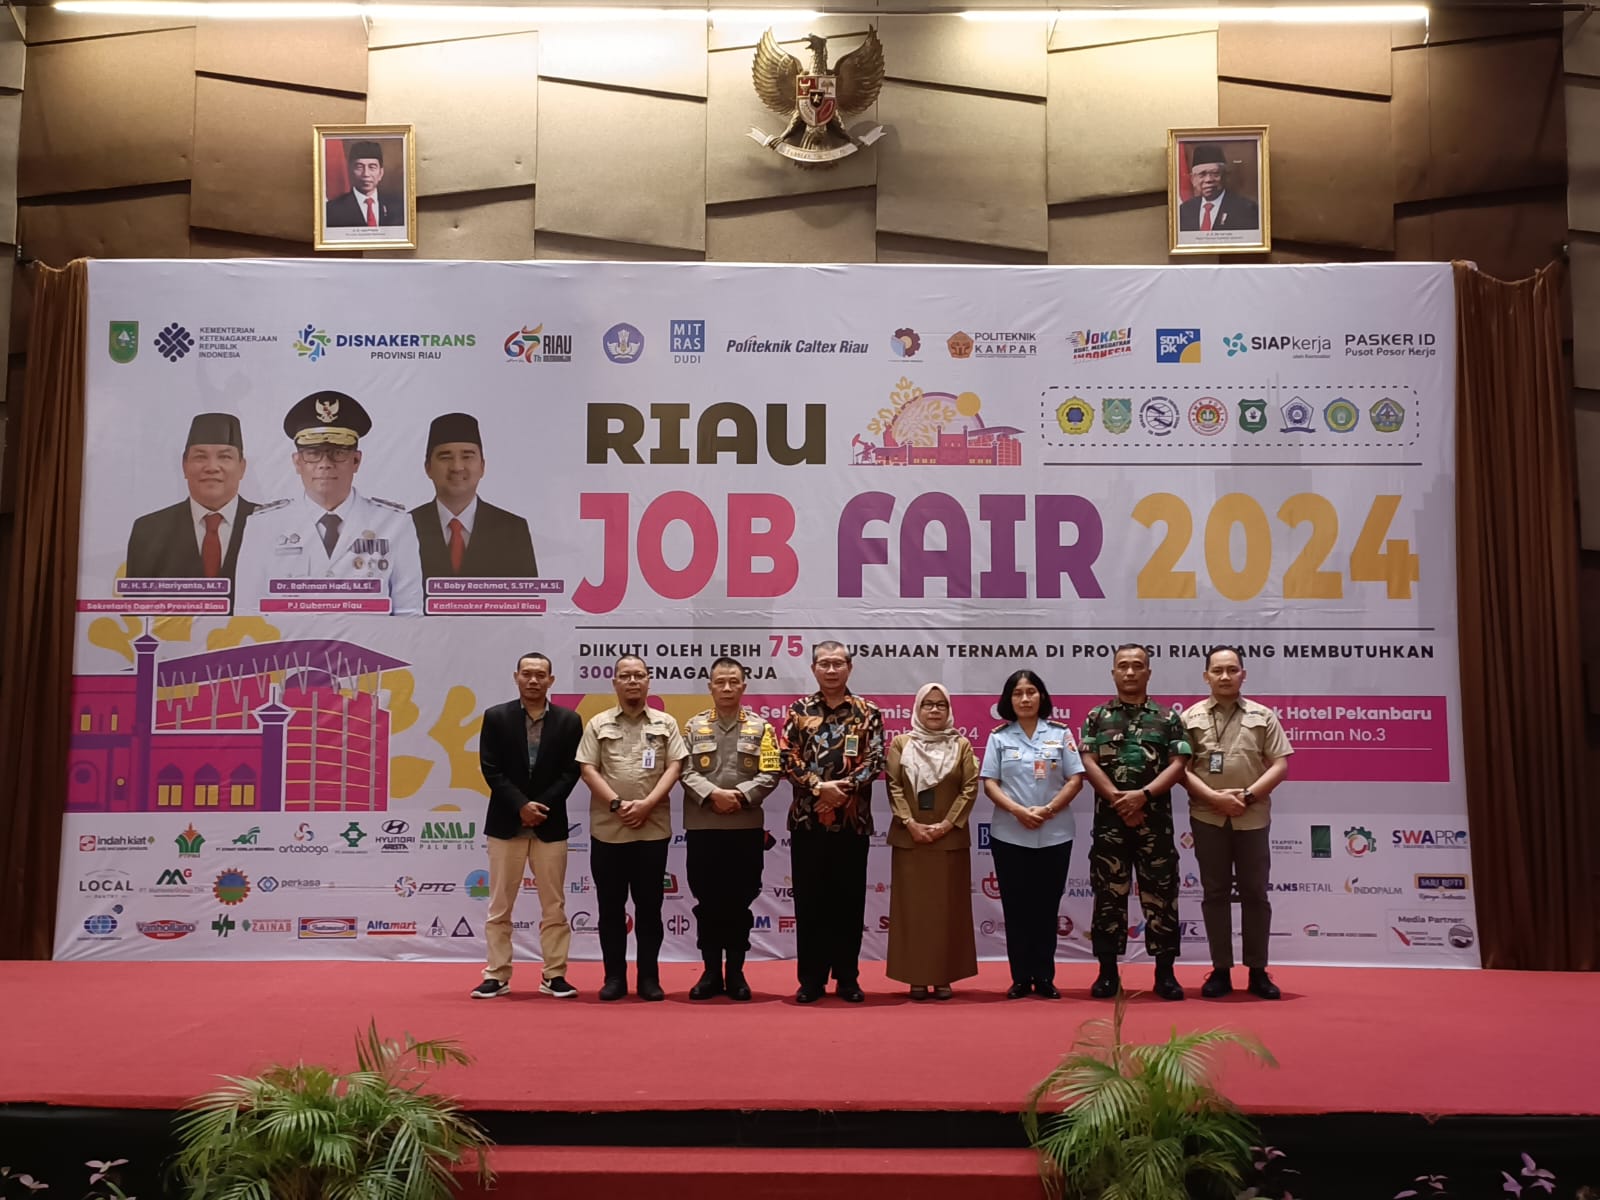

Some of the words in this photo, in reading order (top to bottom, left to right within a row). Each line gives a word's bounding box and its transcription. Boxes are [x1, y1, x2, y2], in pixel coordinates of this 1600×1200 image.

[673, 323, 701, 336] MIT
[336, 334, 476, 347] DISNAKERTRANS
[974, 332, 1036, 342] POLITEKNIK
[1345, 333, 1412, 346] PASKER
[1419, 333, 1436, 346] ID
[543, 335, 572, 354] RIAU
[673, 338, 701, 351] RAS
[726, 338, 792, 353] Politeknik
[795, 339, 836, 353] Caltex
[839, 340, 869, 353] Riau
[974, 344, 1037, 354] KAMPAR
[1159, 343, 1178, 356] pk
[1251, 335, 1332, 353] SIAPkerja
[370, 351, 416, 360] PROVINSI
[418, 351, 442, 360] RIAU
[1345, 347, 1374, 357] Pusat
[1408, 347, 1436, 358] Kerja
[674, 355, 701, 364] DUDI
[586, 401, 827, 466] RIAU
[570, 490, 800, 615] JOB
[836, 491, 1106, 600] FAIR
[1130, 492, 1421, 601] 2024
[276, 582, 289, 590] Dr.
[290, 582, 328, 590] Rahman
[328, 582, 352, 591] Hadi,
[433, 582, 442, 590] H.
[467, 582, 509, 592] Rachmat,
[87, 602, 133, 610] Sekretaris
[133, 602, 166, 610] Daerah
[167, 602, 203, 610] Provinsi
[205, 602, 224, 610] Riau
[433, 602, 483, 610] Kadisnaker
[485, 602, 520, 610] Provinsi
[522, 602, 541, 610] Riau
[579, 643, 649, 657] DIIKUTI
[656, 643, 703, 657] OLEH
[710, 643, 762, 657] LEBIH
[768, 635, 804, 657] 75
[946, 644, 1039, 658] TERNAMA
[1046, 644, 1064, 658] DI
[1283, 644, 1435, 658] MEMBUTUHKAN
[646, 666, 711, 679] ENAGA
[1286, 706, 1332, 721] Hotel
[1335, 706, 1433, 721] Pekanbaru
[1349, 727, 1386, 742] No.3
[97, 836, 127, 846] indah
[127, 836, 147, 846] kiat
[279, 845, 329, 856] artaboga
[79, 880, 135, 892] LOCAL
[280, 878, 321, 889] perkasa
[418, 883, 457, 893] PTC
[1266, 883, 1333, 893] RANSRETAIL
[1353, 886, 1403, 895] INDOPALM
[1398, 915, 1426, 923] Media
[252, 921, 292, 932] ZAINAB
[366, 920, 417, 931] Alfamart
